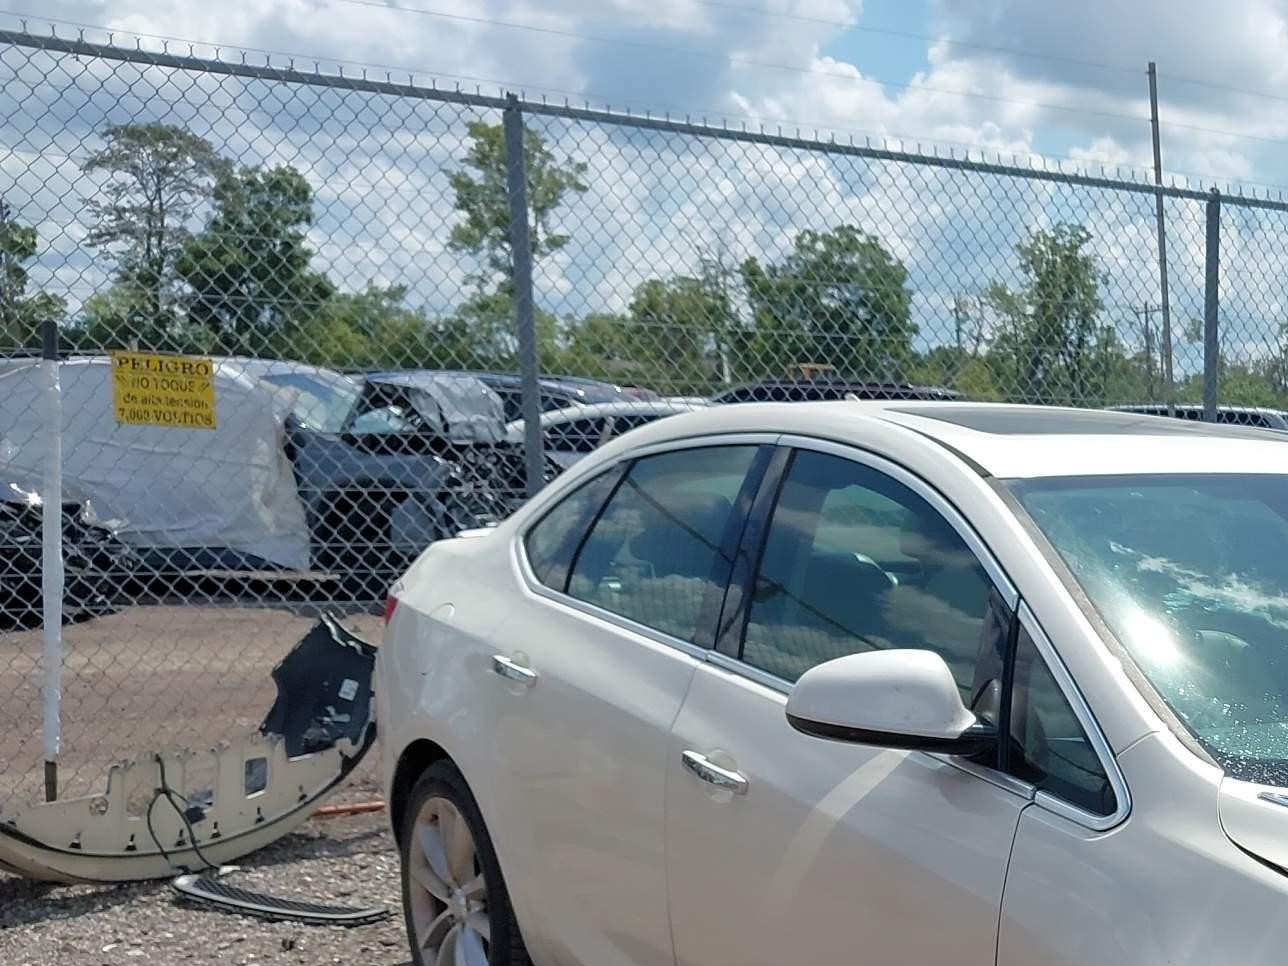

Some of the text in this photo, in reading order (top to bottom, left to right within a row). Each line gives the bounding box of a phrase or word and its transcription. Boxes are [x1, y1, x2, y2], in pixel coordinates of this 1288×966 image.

[118, 357, 209, 376] PELIGRO
[132, 377, 195, 393] NO TOQUE
[123, 392, 137, 403] de
